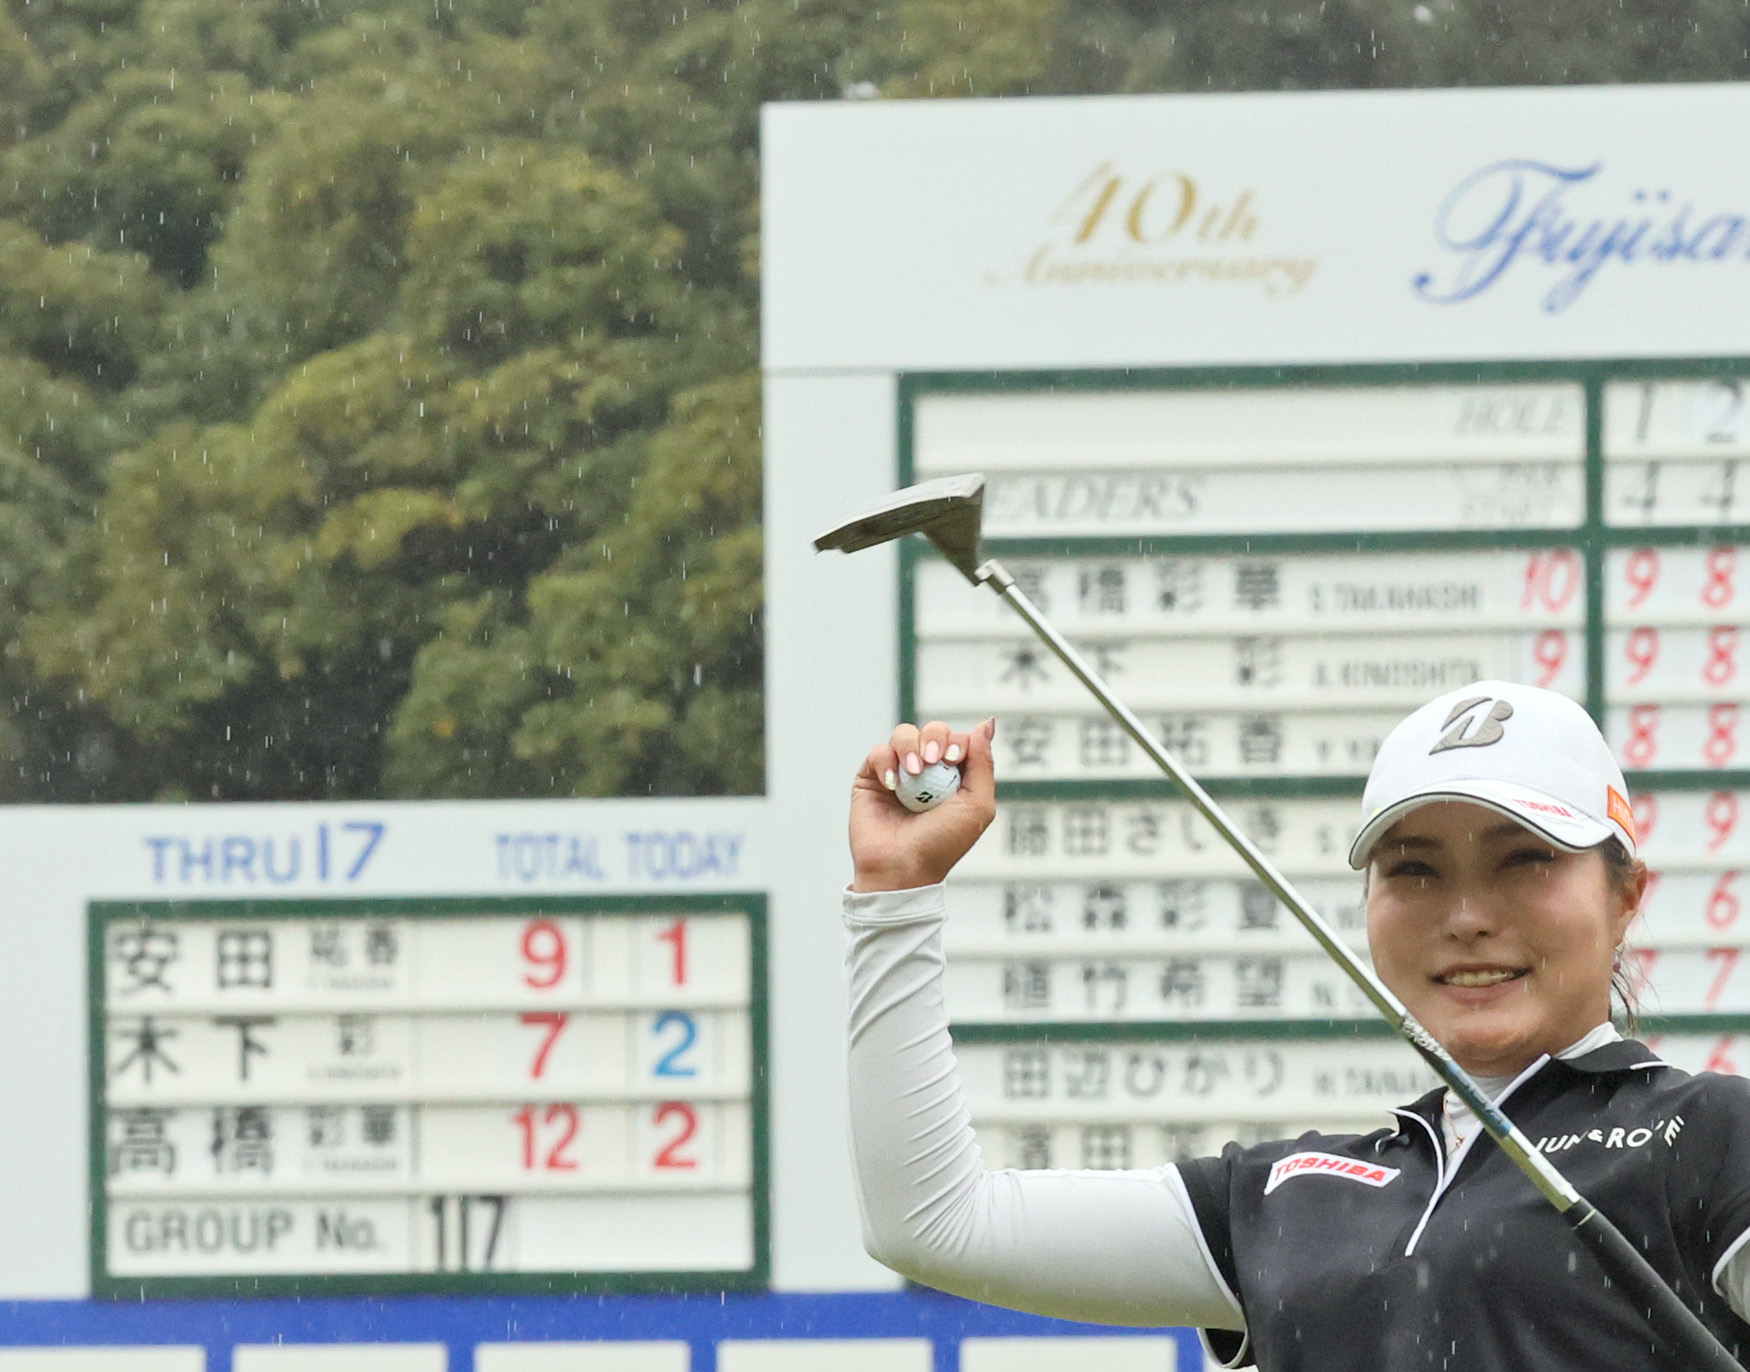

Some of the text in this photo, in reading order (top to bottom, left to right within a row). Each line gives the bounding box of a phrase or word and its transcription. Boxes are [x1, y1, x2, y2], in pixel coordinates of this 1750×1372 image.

[1052, 161, 1258, 247] 40th
[985, 245, 1318, 300] Anniversary
[1636, 384, 1657, 442] 1
[1702, 383, 1744, 442] 2
[985, 473, 1202, 523] EADERS
[1619, 460, 1661, 522] 4
[1697, 459, 1738, 521] 4
[1520, 549, 1581, 611] 10
[1627, 550, 1659, 608] 9
[1702, 548, 1734, 608] 8
[1533, 628, 1568, 687] 9
[1627, 627, 1659, 684] 9
[1704, 625, 1738, 686] 8
[1624, 705, 1657, 768] 8
[1704, 703, 1737, 765] 8
[1706, 792, 1738, 848] 9
[146, 821, 746, 884] THRU 17 TOTAL TODAY
[520, 919, 569, 989] 9
[658, 918, 691, 985] 1
[520, 1011, 570, 1079] 7
[652, 1010, 699, 1077] 2
[513, 1102, 581, 1171] 12
[653, 1103, 699, 1169] 2
[1274, 1156, 1386, 1183] TOSHIBA
[125, 1212, 293, 1255] GROUP
[316, 1209, 386, 1254] No.
